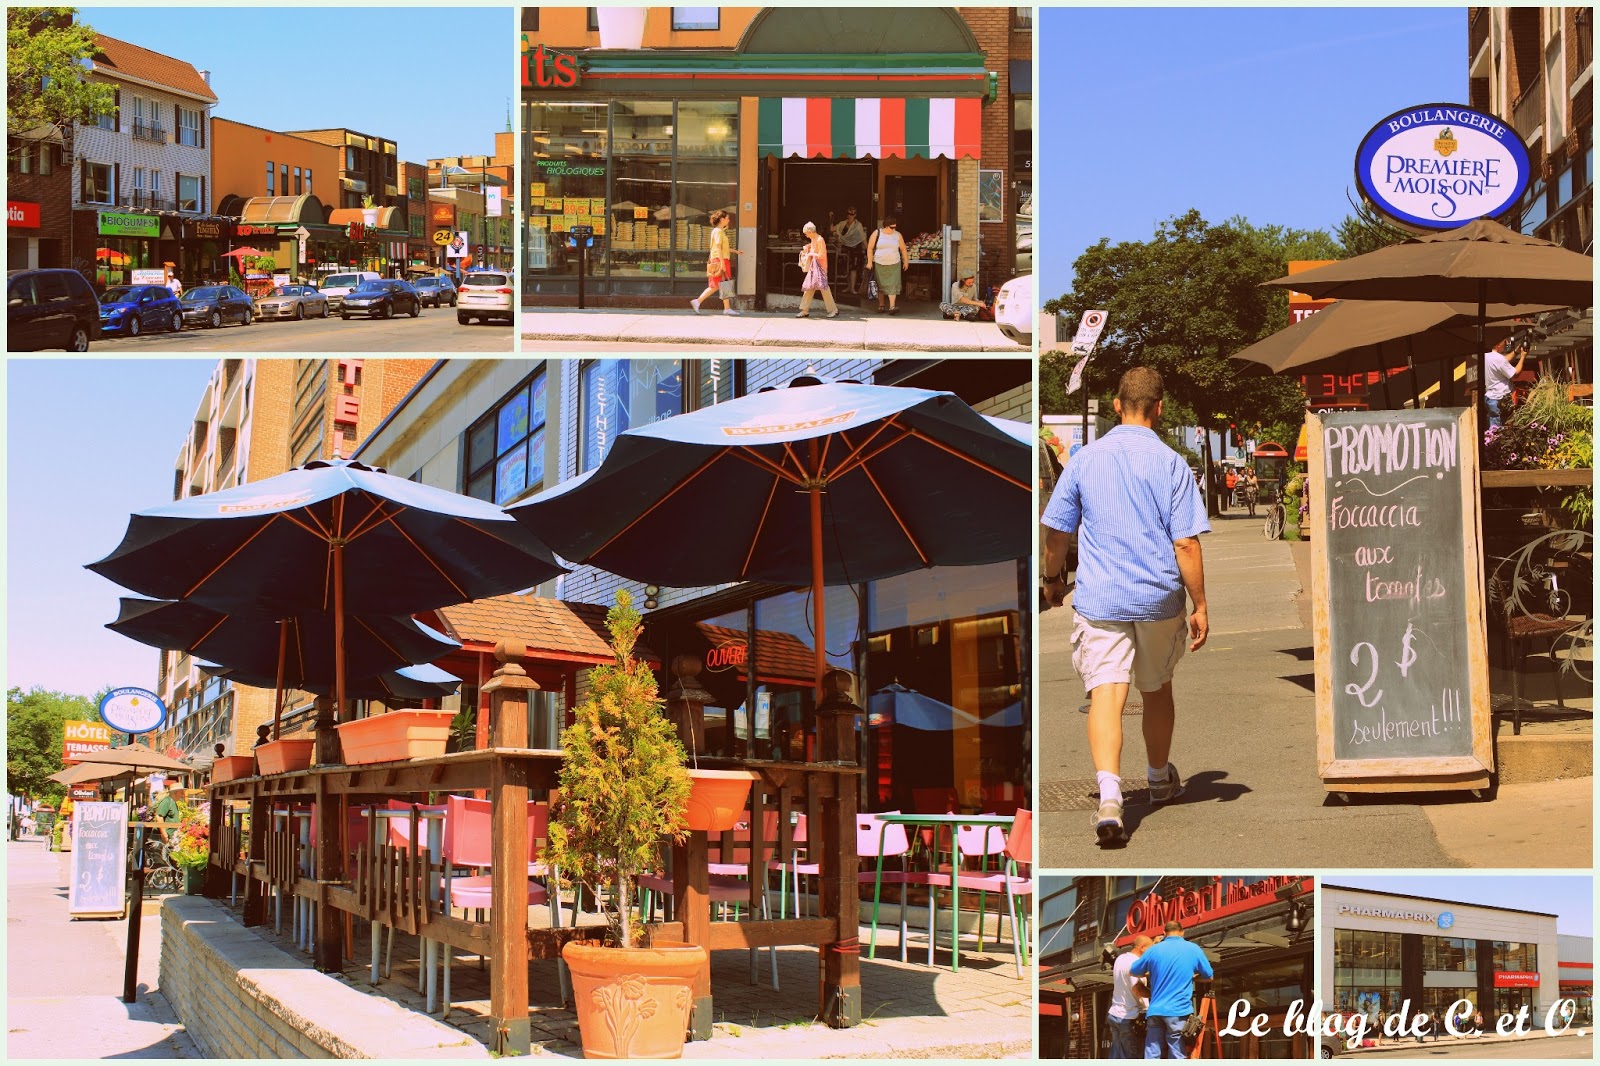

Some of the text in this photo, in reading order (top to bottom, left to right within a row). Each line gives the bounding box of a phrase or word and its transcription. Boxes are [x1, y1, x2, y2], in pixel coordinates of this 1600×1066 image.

[1387, 109, 1507, 139] BOULANGERIE
[546, 167, 605, 176] BIOLOGIQUES
[1385, 155, 1501, 188] PREMIÈRE
[107, 216, 154, 228] BIOGUMES
[435, 232, 451, 241] 24
[1324, 422, 1457, 478] PROMOTION
[1355, 546, 1395, 567] aux
[706, 645, 746, 667] OUVERT
[1345, 623, 1417, 708] 2 $
[113, 689, 159, 703] BOULANGERIE
[66, 724, 110, 740] HÔTEL
[66, 743, 109, 752] TERRASSE
[1126, 876, 1222, 935] Olivieri
[1339, 904, 1436, 923] PHARMAPRIX
